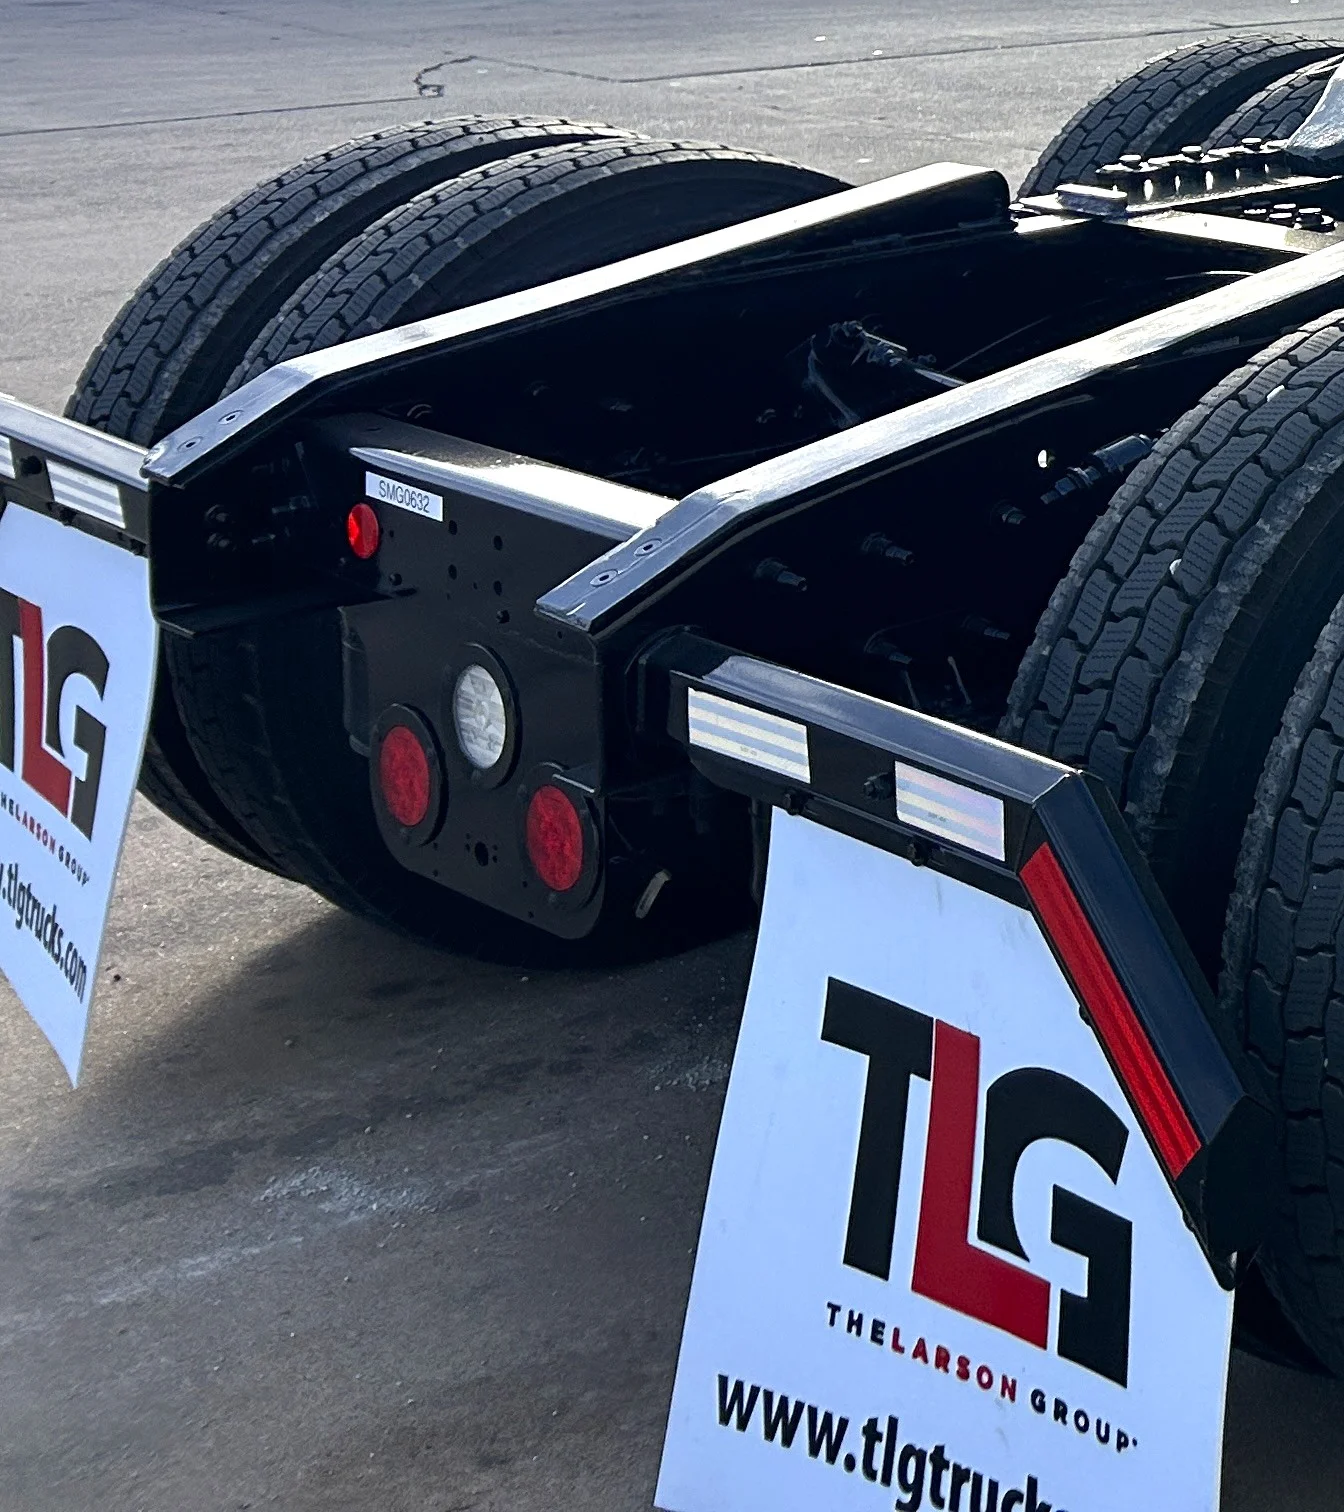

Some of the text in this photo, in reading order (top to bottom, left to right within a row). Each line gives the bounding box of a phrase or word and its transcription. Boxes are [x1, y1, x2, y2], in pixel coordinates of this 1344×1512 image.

[379, 479, 430, 514] SMG0632
[58, 845, 88, 887] GROUP
[0, 862, 87, 1004] .tlgtrucks.com
[820, 975, 1133, 1389] TLG
[1030, 1389, 1130, 1454] GROUP
